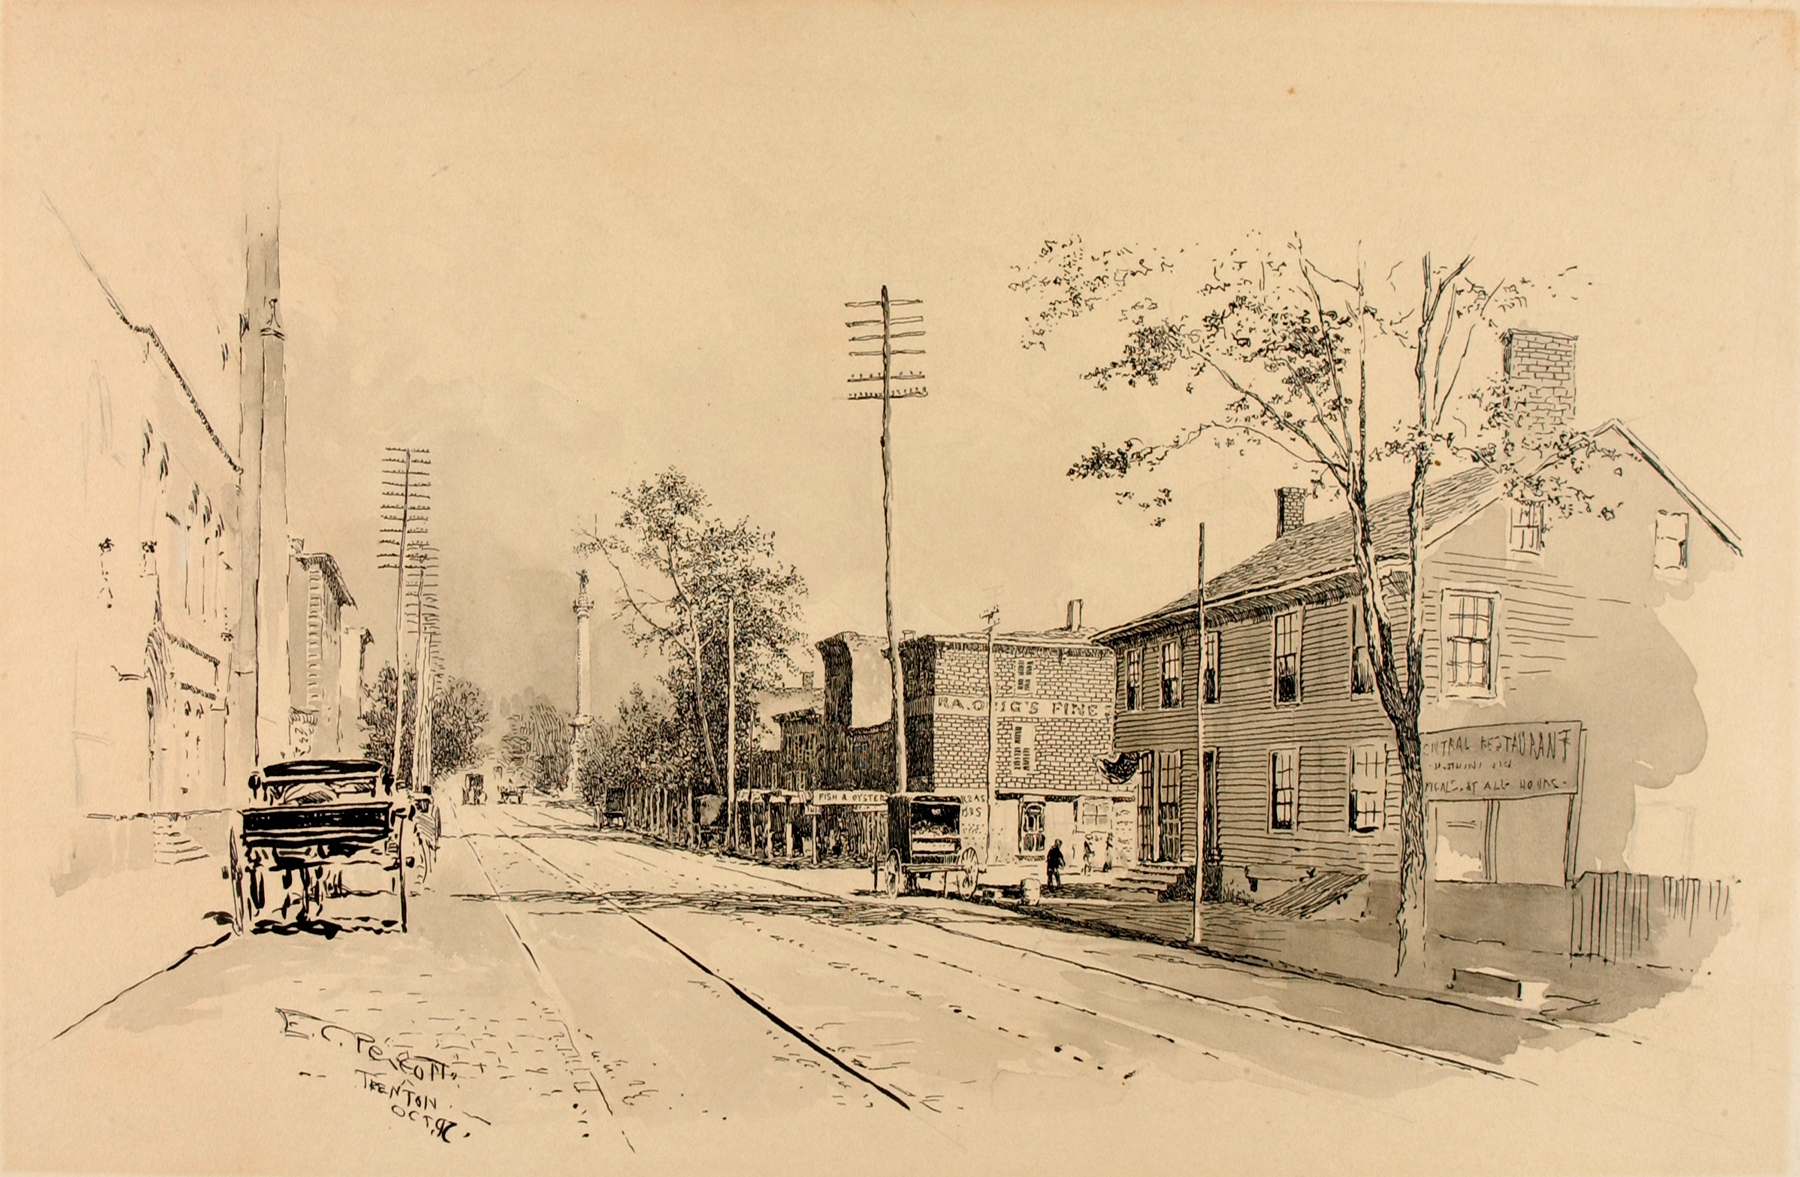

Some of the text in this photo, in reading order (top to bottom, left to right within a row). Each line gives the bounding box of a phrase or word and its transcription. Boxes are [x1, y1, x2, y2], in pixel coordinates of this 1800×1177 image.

[1052, 702, 1098, 717] FINE
[819, 793, 838, 801] FISH
[355, 1069, 437, 1110] TRENTON
